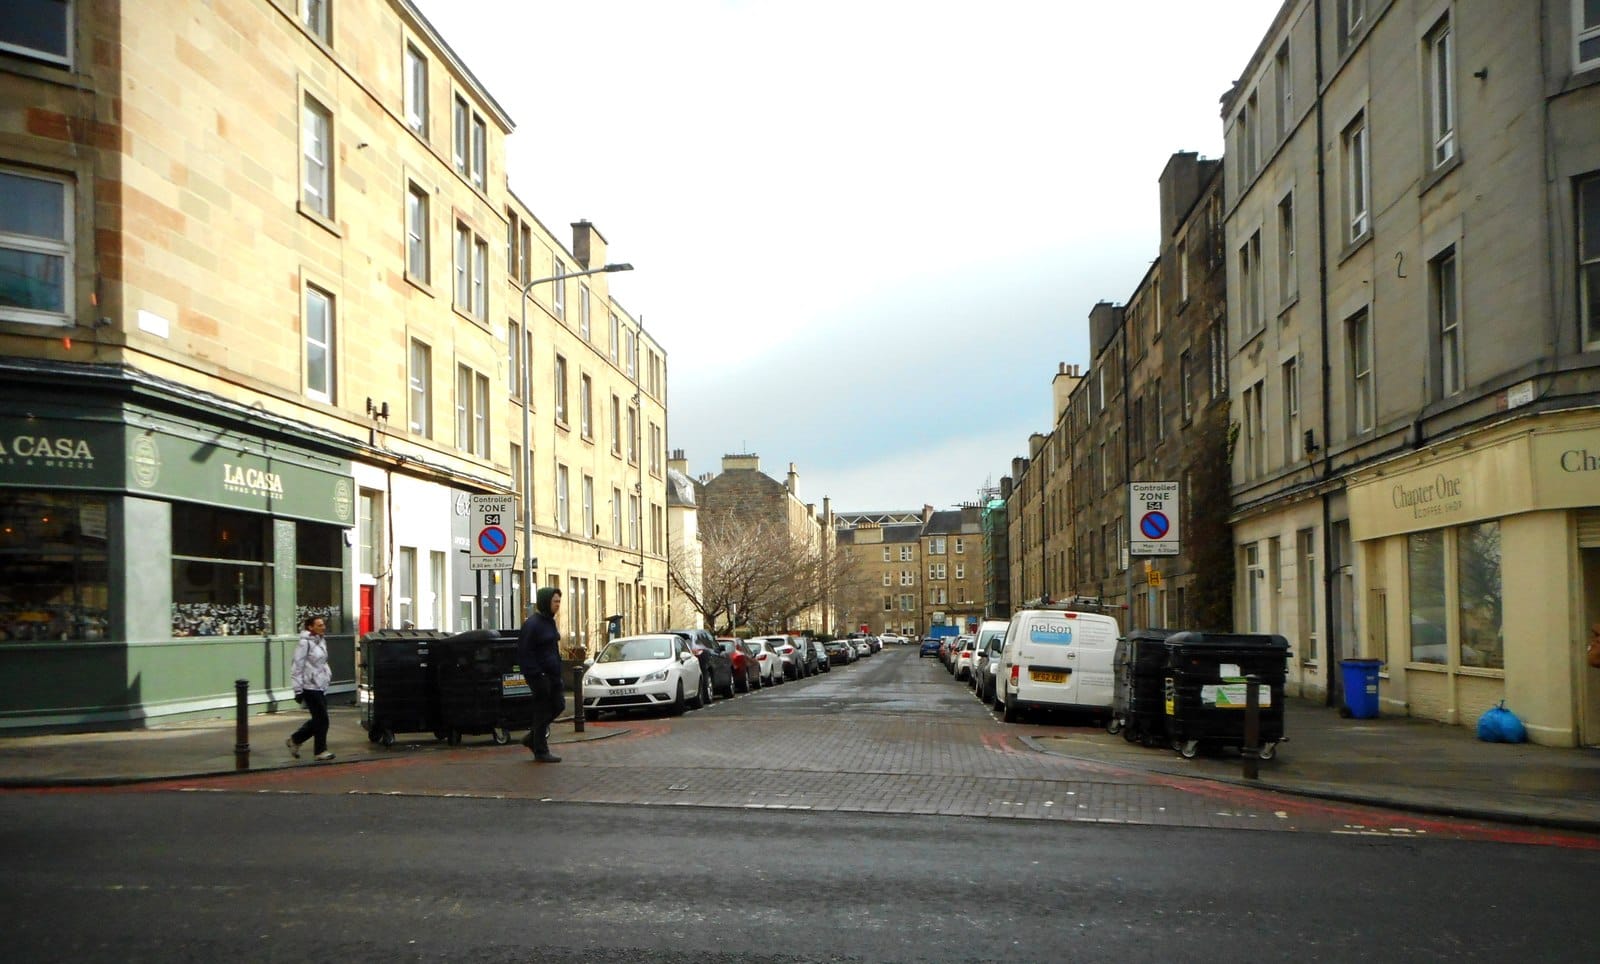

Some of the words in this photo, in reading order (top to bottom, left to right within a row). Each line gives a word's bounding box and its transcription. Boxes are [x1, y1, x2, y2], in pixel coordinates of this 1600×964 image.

[13, 435, 95, 460] CASA
[1560, 449, 1600, 473] Ch
[223, 463, 246, 486] LA
[246, 467, 284, 493] CASA
[1132, 484, 1177, 492] Controlled
[1139, 492, 1170, 501] ZONE
[1392, 484, 1434, 519] Chapter
[1436, 473, 1461, 500] One
[479, 504, 506, 513] ZONE
[1147, 502, 1161, 510] S4
[485, 515, 499, 525] S4
[1150, 572, 1160, 585] H
[1031, 623, 1072, 635] nelson
